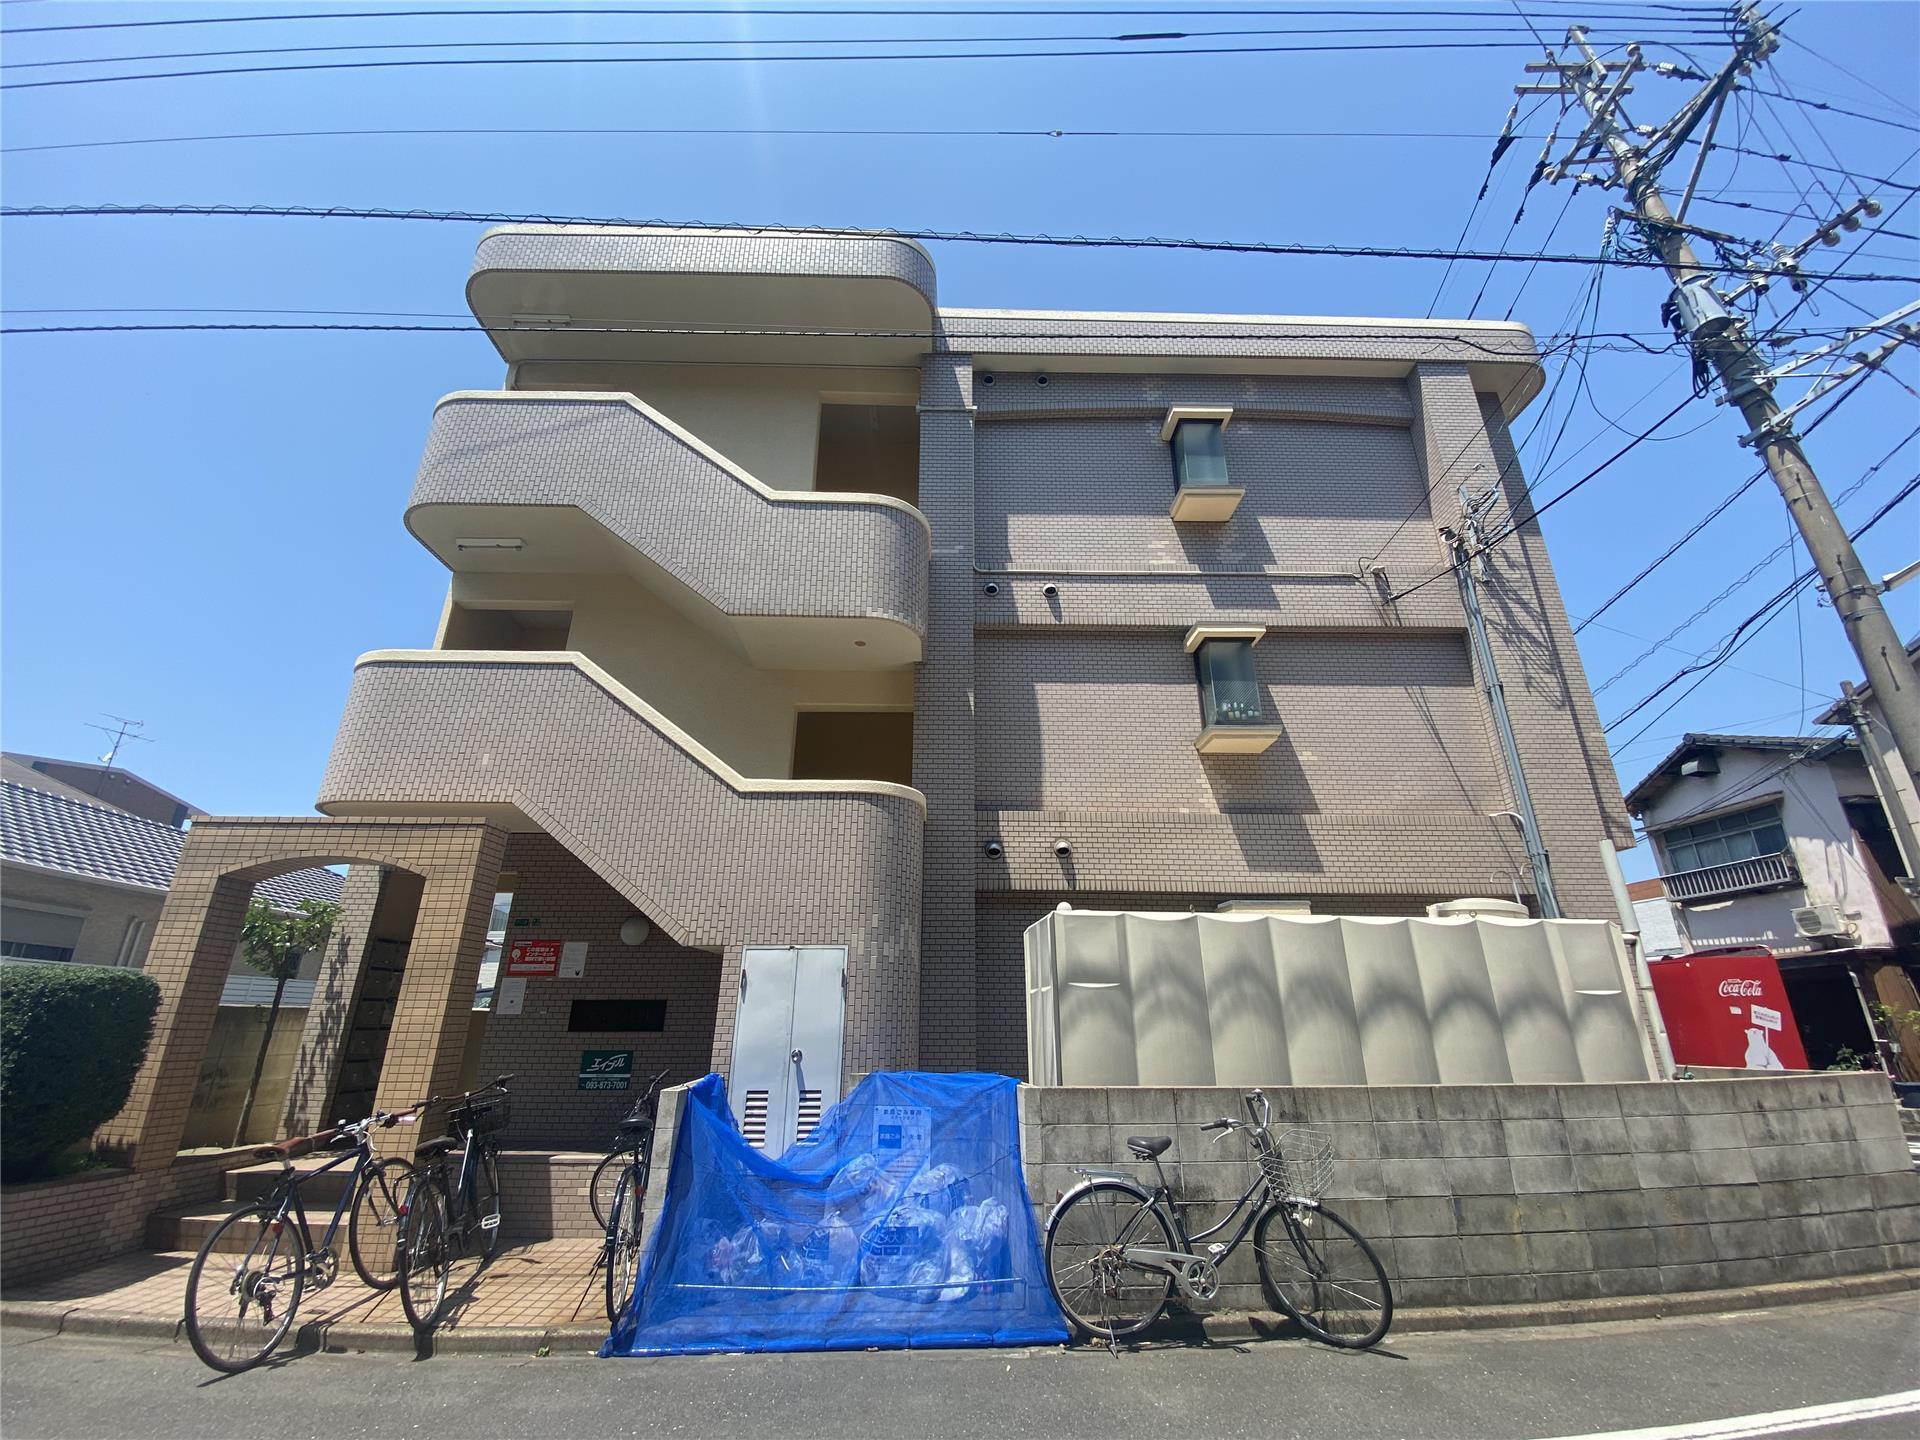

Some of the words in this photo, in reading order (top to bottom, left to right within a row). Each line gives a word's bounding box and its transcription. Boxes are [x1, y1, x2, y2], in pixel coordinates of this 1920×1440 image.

[1718, 979, 1763, 997] Coca-Cola
[586, 1053, 628, 1072] エイブル
